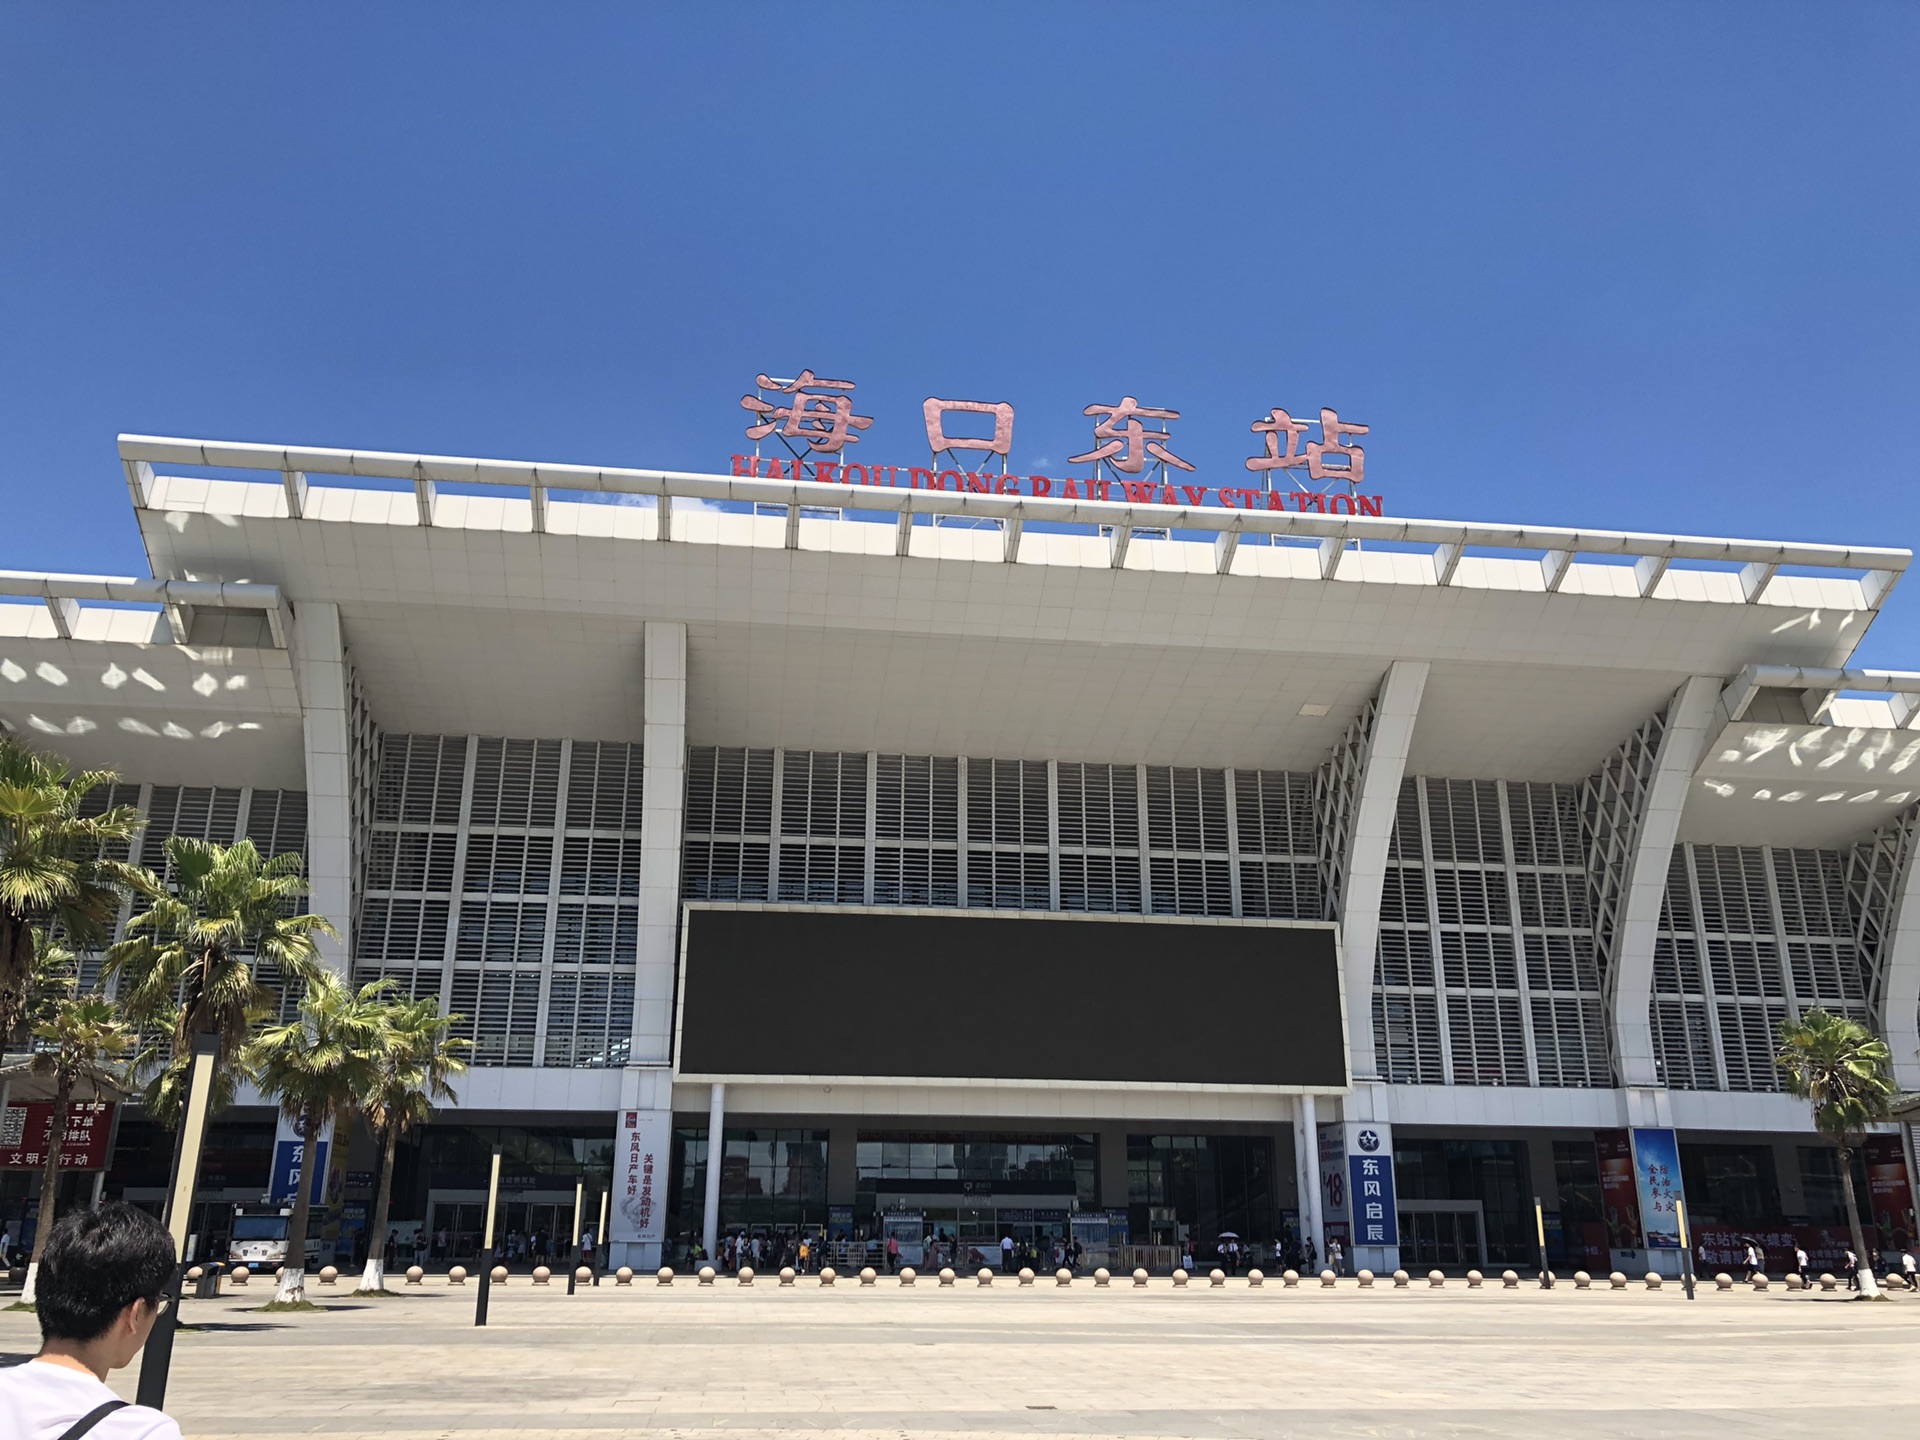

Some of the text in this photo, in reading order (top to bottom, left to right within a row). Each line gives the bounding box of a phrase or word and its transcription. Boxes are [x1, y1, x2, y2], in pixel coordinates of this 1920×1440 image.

[740, 369, 1370, 483] 海口东站
[627, 1132, 641, 1196] 东风日产车好
[639, 1153, 654, 1229] 关键是发动机好
[1647, 1164, 1663, 1213] 全民参与
[1659, 1164, 1677, 1213] 防治火灾
[1362, 1158, 1385, 1241] 东风启辰
